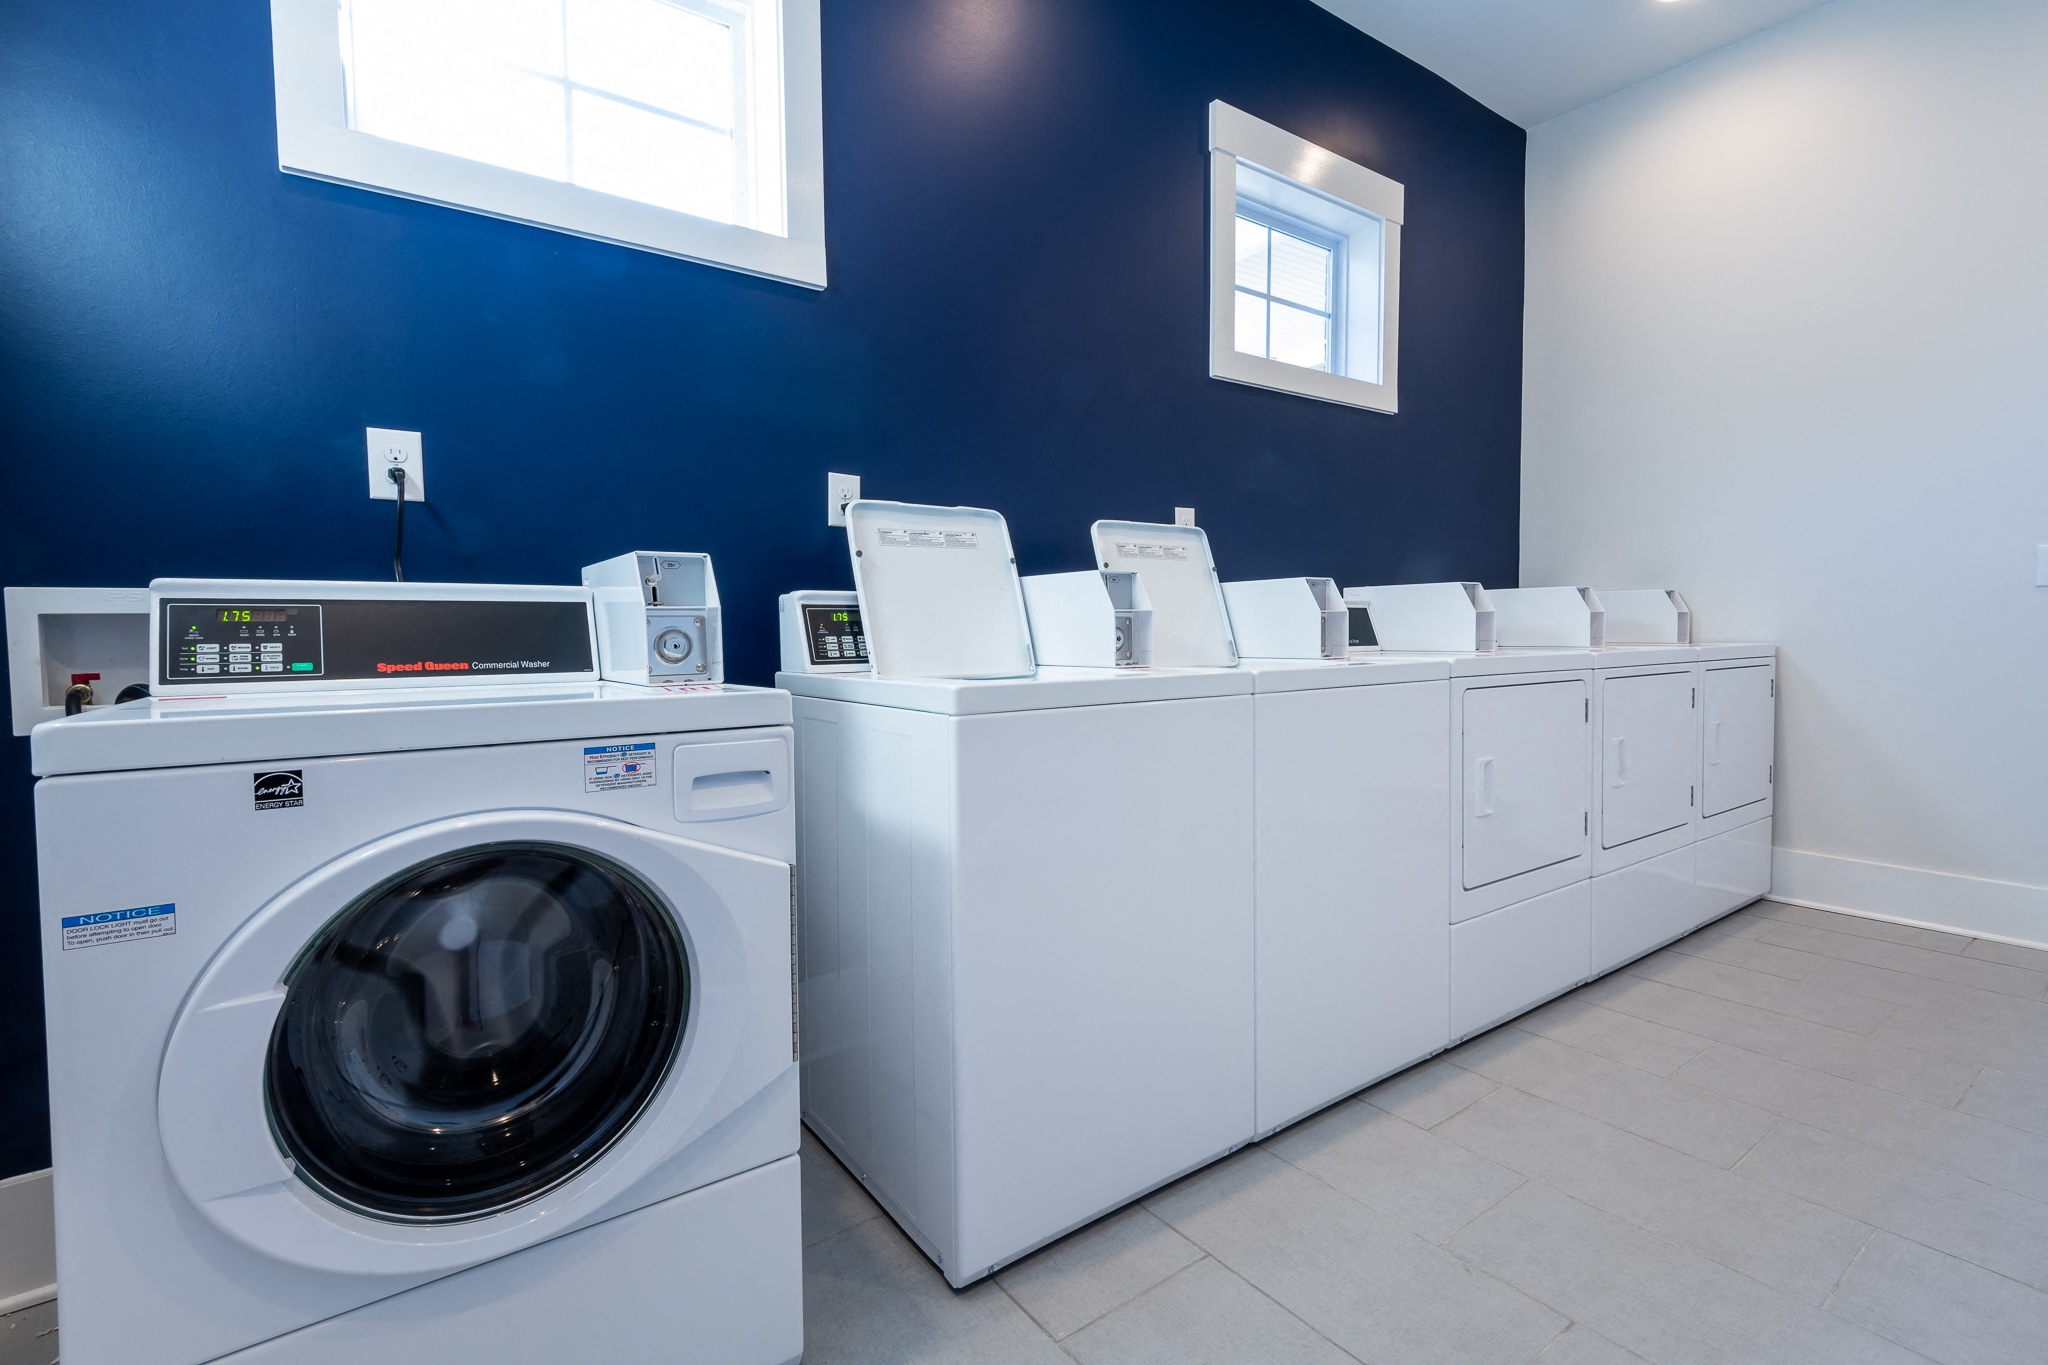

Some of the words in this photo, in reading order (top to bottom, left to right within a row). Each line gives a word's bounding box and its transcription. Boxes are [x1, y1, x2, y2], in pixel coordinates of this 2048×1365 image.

[222, 610, 250, 622] 1.75
[377, 662, 422, 673] Speed
[424, 662, 469, 671] Queen
[472, 660, 520, 670] Commercial
[521, 660, 550, 668] Washer
[80, 906, 161, 924] NOTICE
[89, 929, 122, 937] attempting
